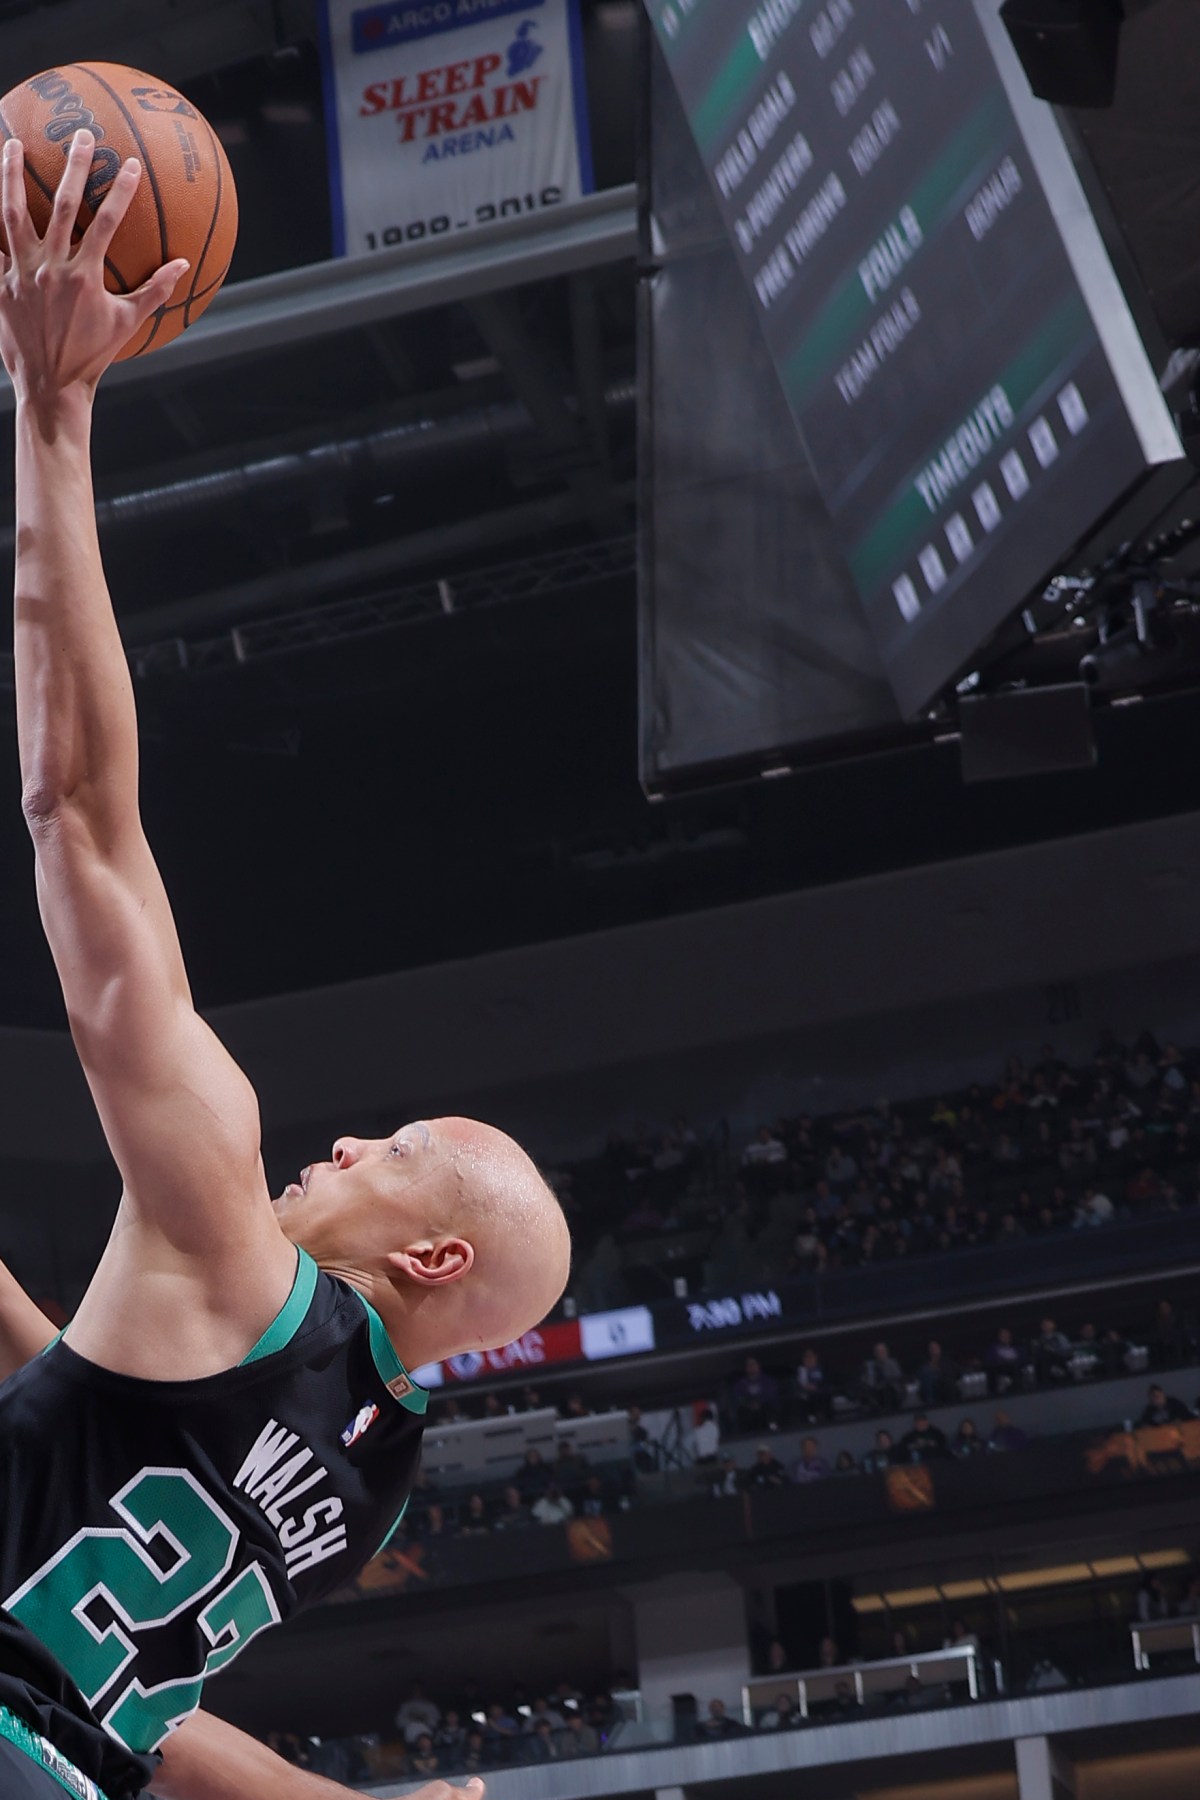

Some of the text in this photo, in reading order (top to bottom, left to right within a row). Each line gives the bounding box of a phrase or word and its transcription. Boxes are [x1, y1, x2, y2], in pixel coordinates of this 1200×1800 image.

[360, 53, 503, 118] SLEEP
[397, 76, 543, 144] TRAIN
[421, 123, 515, 164] ARENA
[858, 205, 924, 304] FOULS
[914, 383, 1015, 514] TIMEOUTS
[233, 1418, 348, 1581] WALSH
